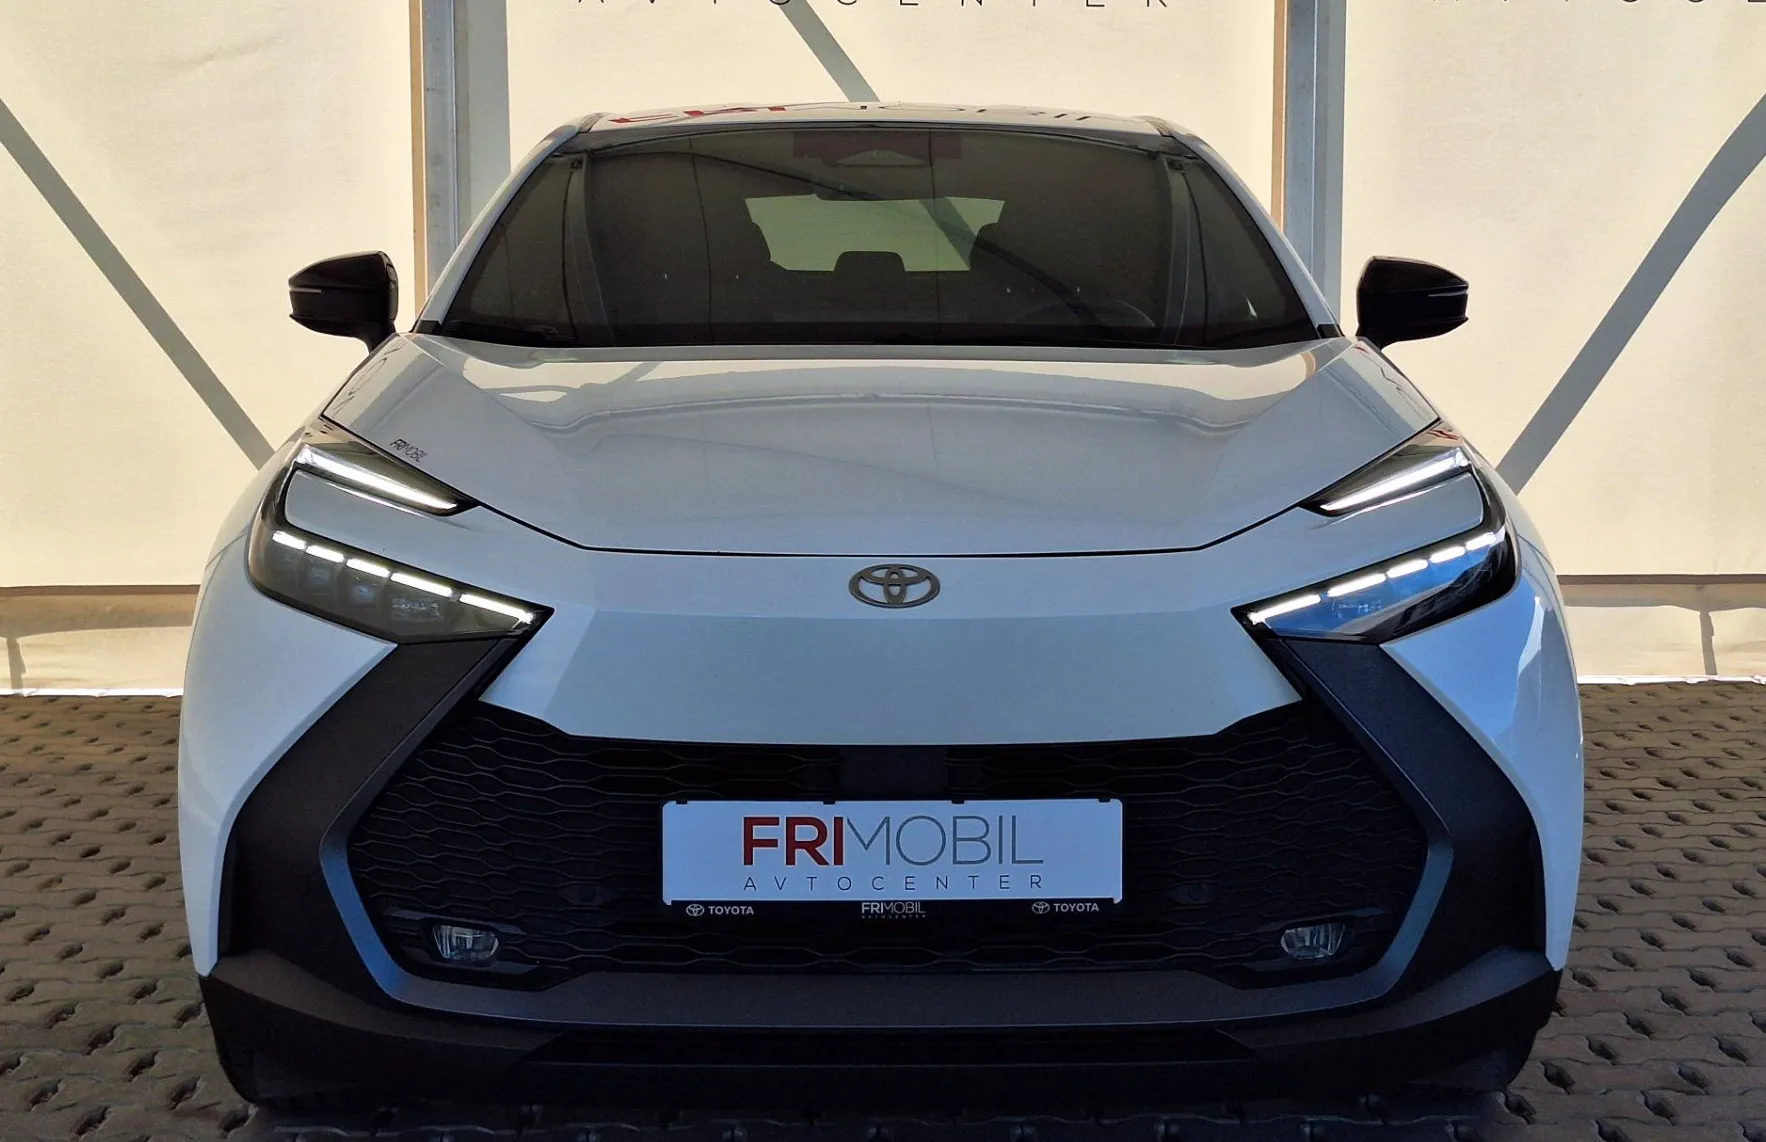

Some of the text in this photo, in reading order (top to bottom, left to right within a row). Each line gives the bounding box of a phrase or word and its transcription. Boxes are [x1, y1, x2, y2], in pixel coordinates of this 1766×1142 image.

[743, 815, 1043, 866] FRIMOBIL
[743, 875, 1042, 891] AVTOCENTER
[708, 906, 754, 915] TOYOTA
[861, 901, 927, 914] FRIMOBIL
[1053, 903, 1099, 912] TOYOTA
